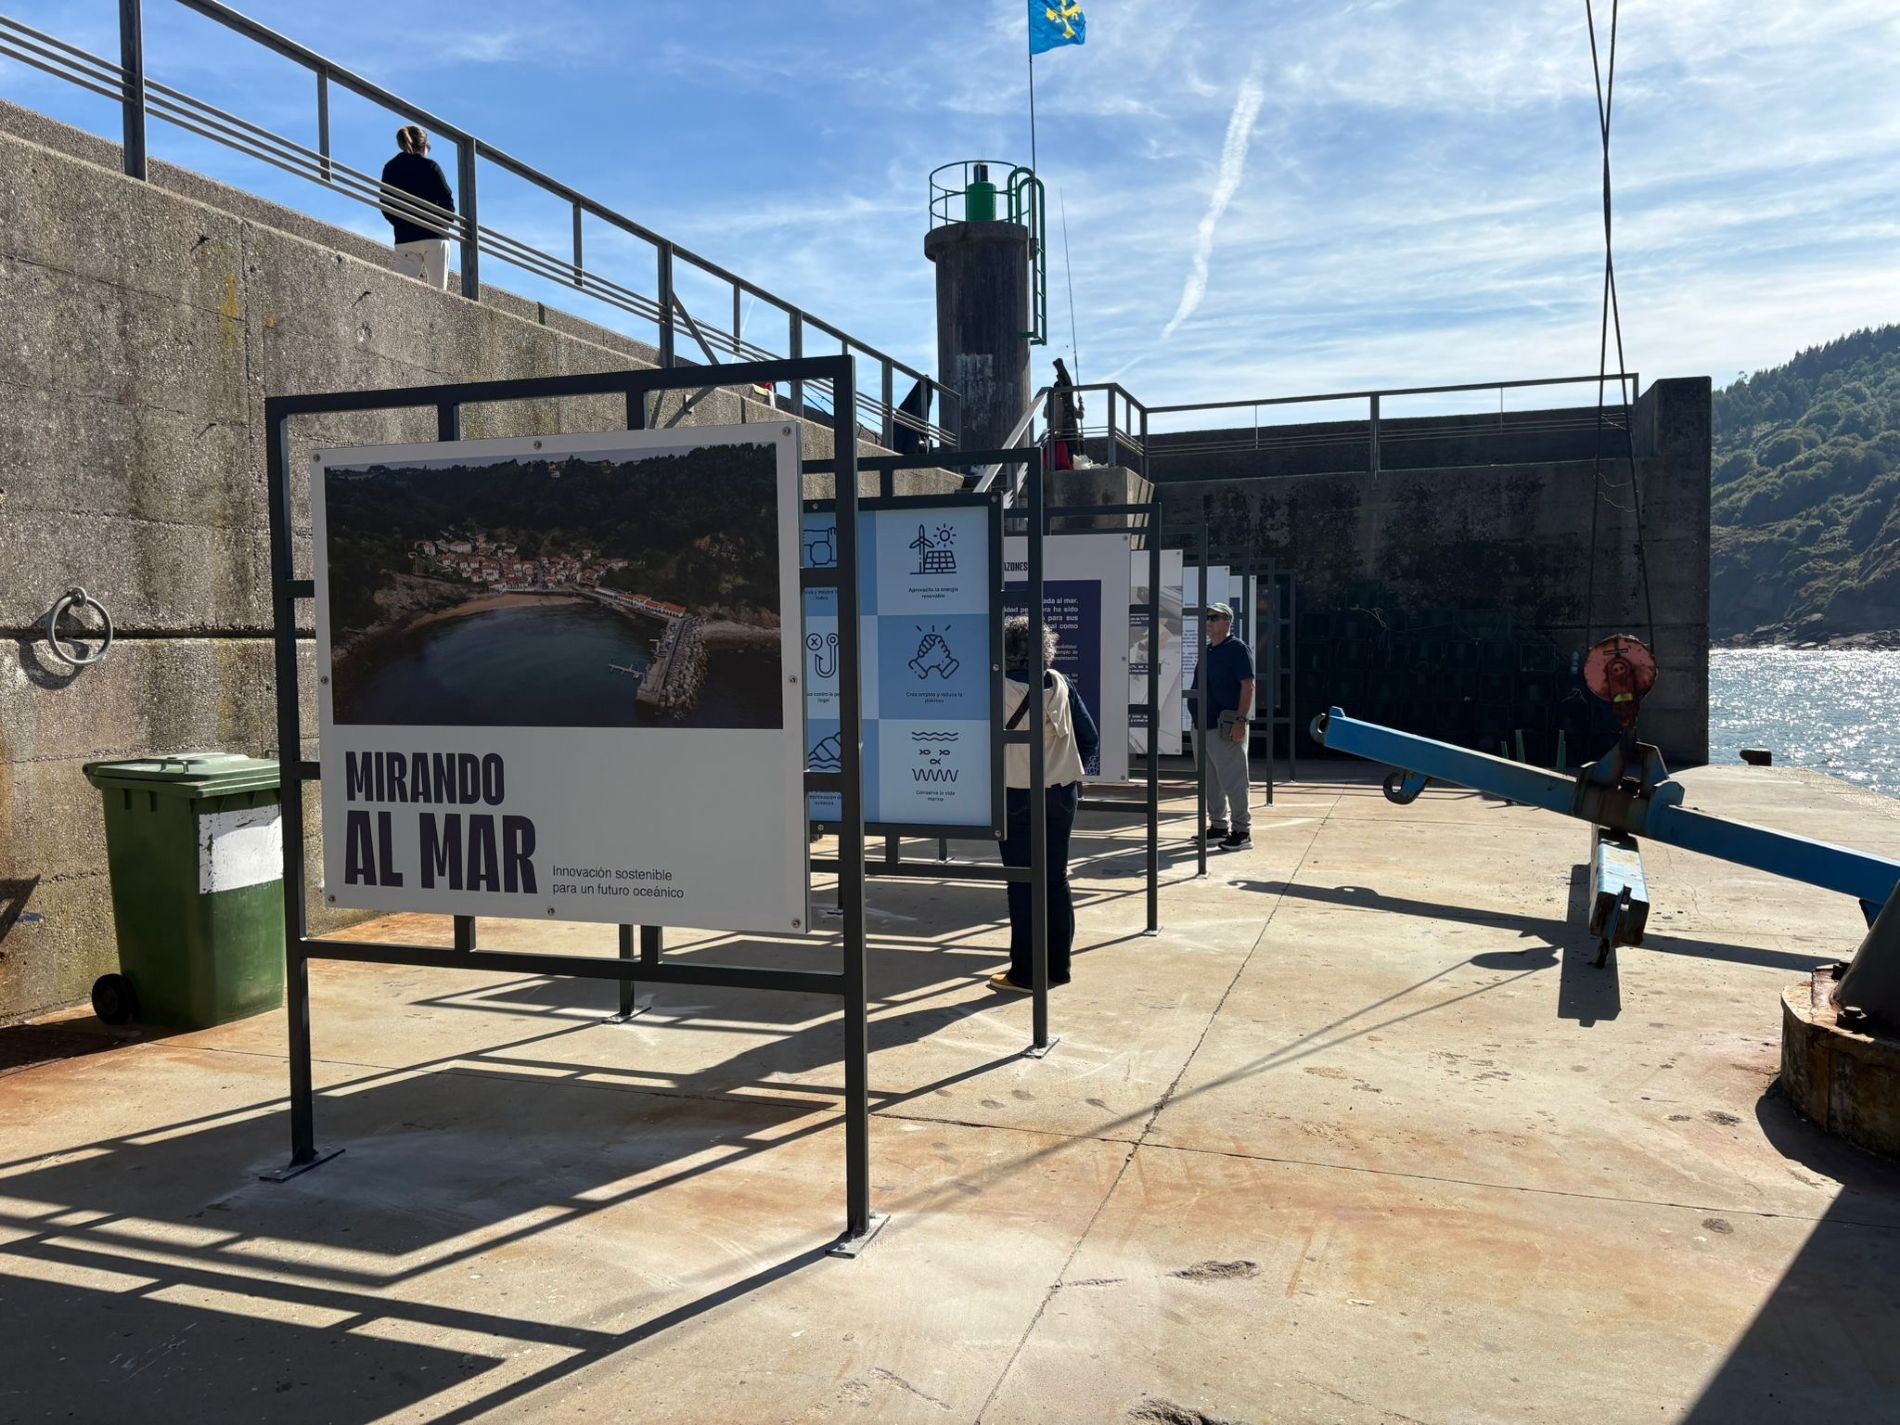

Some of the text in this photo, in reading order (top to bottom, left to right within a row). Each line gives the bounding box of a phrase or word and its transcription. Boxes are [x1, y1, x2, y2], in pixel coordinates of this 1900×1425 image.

[345, 751, 505, 806] MIRANDO
[344, 810, 538, 894] AL MAR
[552, 865, 673, 881] Innovación sostenible
[552, 883, 685, 899] para un futuro oceánico
